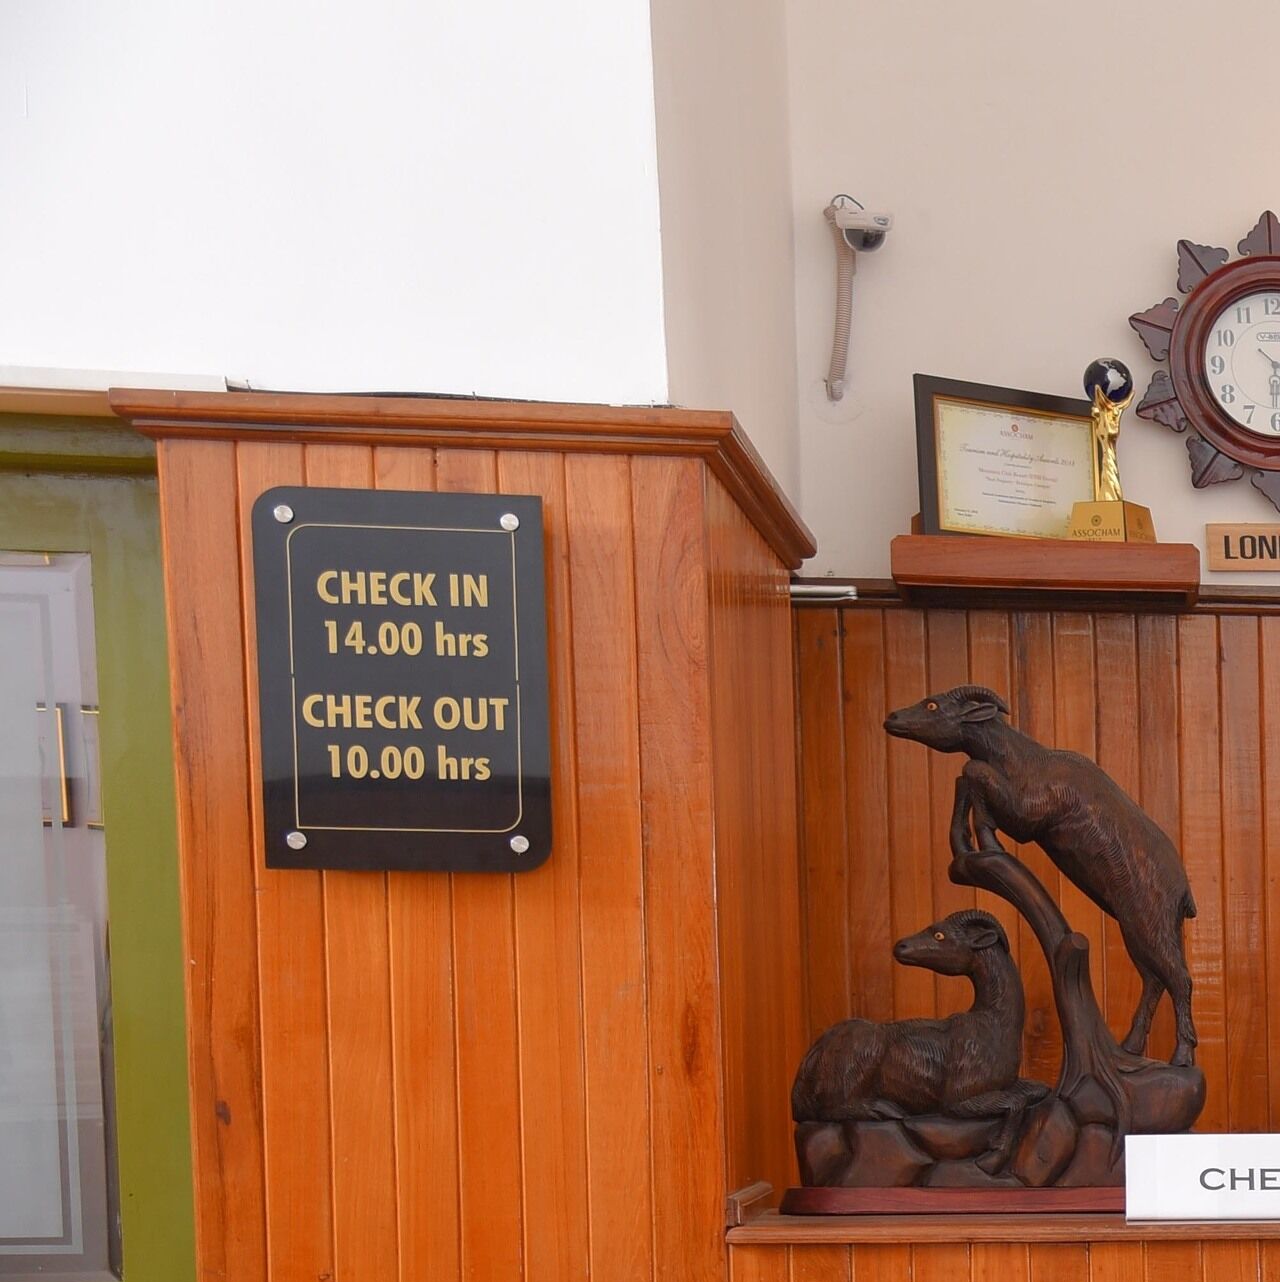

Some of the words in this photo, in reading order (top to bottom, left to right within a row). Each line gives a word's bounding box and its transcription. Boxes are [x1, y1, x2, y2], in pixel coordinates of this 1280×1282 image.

[1237, 307, 1251, 324] 11
[1264, 299, 1280, 316] 12
[1217, 329, 1234, 346] 10
[1211, 356, 1224, 374] 9
[1221, 384, 1234, 403] 8
[1243, 405, 1255, 424] 7
[1072, 528, 1120, 537] ASSOCHAM
[316, 570, 438, 607] CHECK
[449, 574, 489, 607] IN
[324, 621, 423, 656] 14.00
[435, 621, 489, 657] hrs
[302, 694, 423, 730] CHECK
[433, 697, 509, 731] OUT
[327, 744, 426, 779] 10.00
[437, 745, 491, 781] hrs
